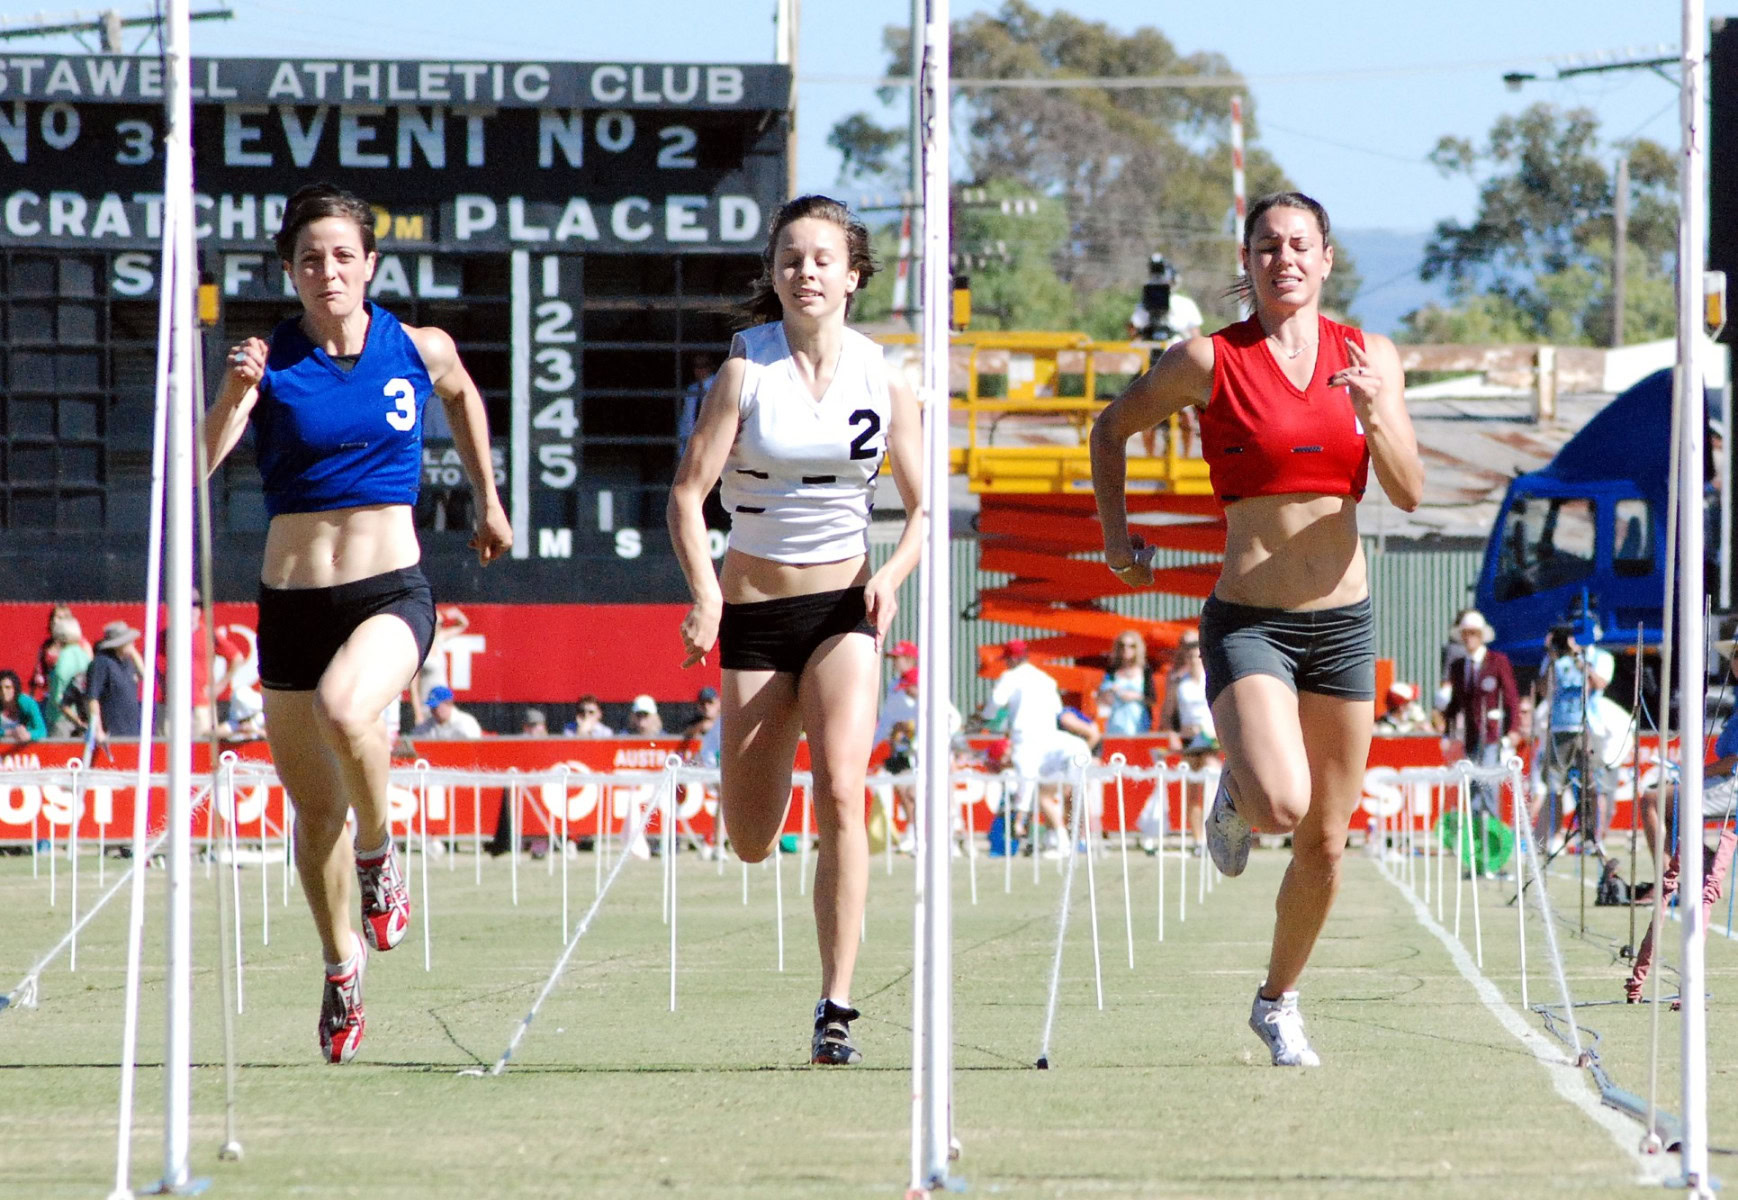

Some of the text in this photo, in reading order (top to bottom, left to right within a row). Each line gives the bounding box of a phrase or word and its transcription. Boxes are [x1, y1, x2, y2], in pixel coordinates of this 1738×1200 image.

[267, 61, 551, 101] ATHLETIC
[590, 65, 745, 103] CLUB
[114, 120, 155, 165] 3
[223, 104, 498, 169] EVENT
[656, 126, 698, 169] 2
[454, 193, 761, 243] PLACED
[534, 301, 577, 344] 2
[534, 348, 576, 393] 3
[383, 377, 417, 432] 3
[533, 397, 579, 438] 4
[848, 408, 881, 461] 2
[539, 443, 578, 489] 5
[539, 528, 572, 559] M
[615, 529, 643, 560] S
